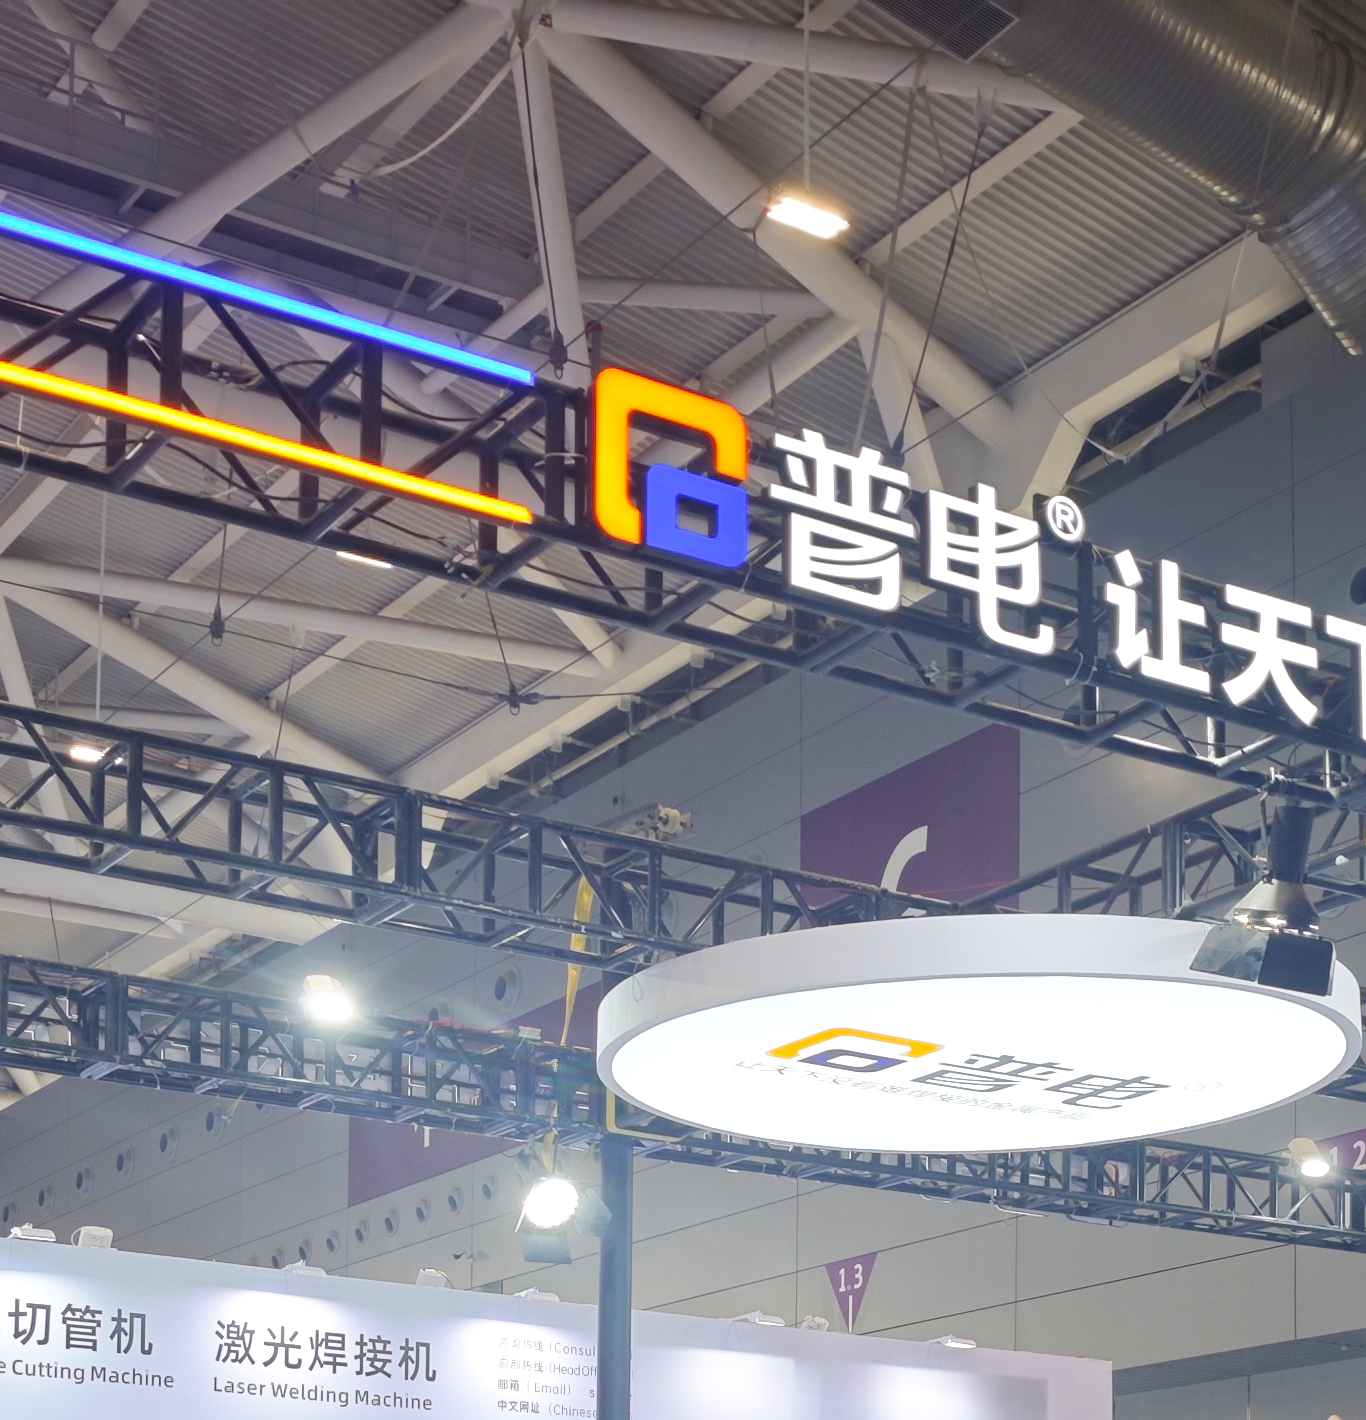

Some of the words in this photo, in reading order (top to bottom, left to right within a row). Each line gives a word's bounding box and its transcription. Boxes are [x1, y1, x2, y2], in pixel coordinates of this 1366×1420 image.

[838, 1263, 864, 1293] 1.3
[214, 1319, 437, 1382] 激光焊接机
[12, 1357, 85, 1384] Cutting
[91, 1363, 175, 1388] Machine
[213, 1376, 265, 1396] Laser
[271, 1381, 349, 1407] Welding
[355, 1388, 433, 1411] Machine
[498, 1399, 540, 1414] 中文网址
